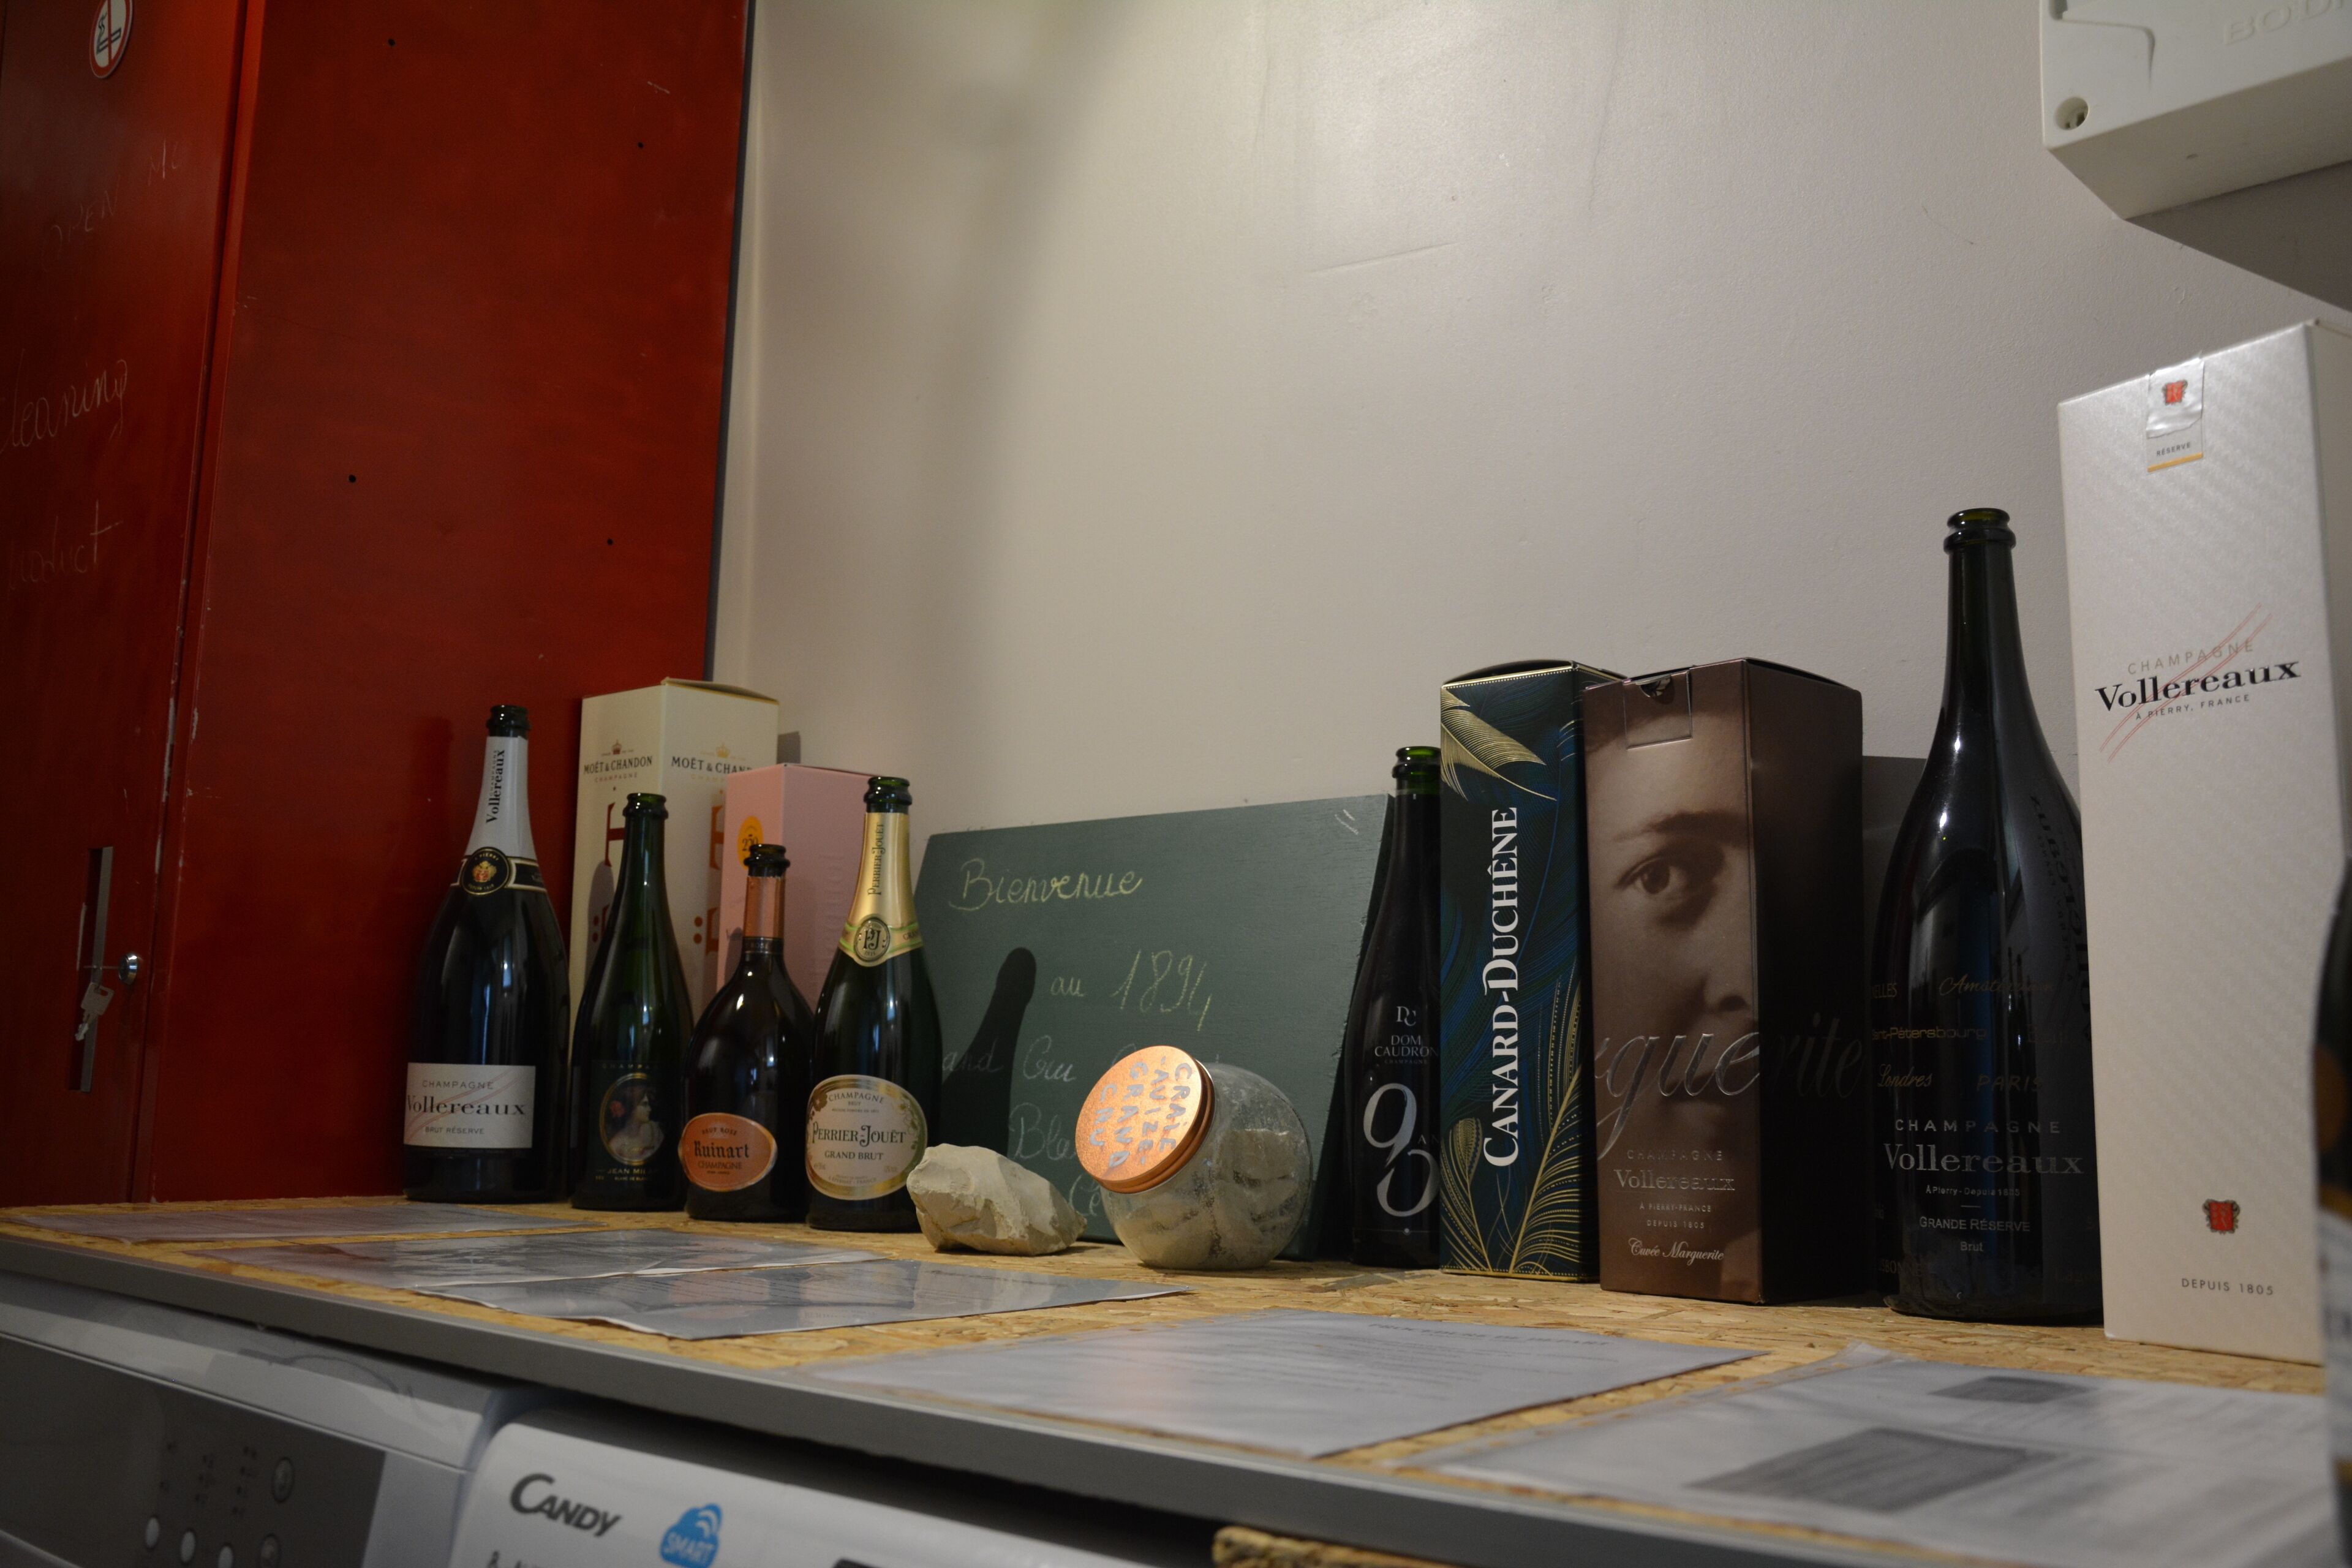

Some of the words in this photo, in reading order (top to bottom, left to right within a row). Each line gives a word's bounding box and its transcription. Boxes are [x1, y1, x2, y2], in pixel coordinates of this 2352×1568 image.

[2156, 442, 2191, 456] RÉSERVE
[2128, 638, 2254, 674] CHAMPAGNE
[2095, 662, 2301, 712] Vollereaux
[2201, 694, 2250, 709] FRANCE
[611, 756, 653, 771] CHANDON
[671, 755, 704, 771] MOËT
[706, 762, 713, 772] &
[486, 750, 505, 823] Vollereaux
[949, 858, 1143, 911] Bienvenue
[1050, 976, 1085, 997] au
[1109, 949, 1212, 1031] 1894
[1391, 1035, 1422, 1046] DOM
[942, 1038, 1004, 1073] and
[1374, 1046, 1439, 1057] CAUDRON
[1876, 1063, 1933, 1088] Londres
[1977, 1073, 2044, 1093] PARIS
[423, 1079, 494, 1090] CHAMPAGNE
[407, 1095, 526, 1115] Vollereaux
[828, 1091, 884, 1104] CHAMPAGNE
[446, 1125, 485, 1134] RÉSERVE
[1895, 1119, 2060, 1134] CHAMPAGNE
[694, 1140, 749, 1158] Ruinart
[824, 1150, 856, 1159] GRAND
[858, 1152, 883, 1161] BRUT
[1626, 1149, 1722, 1161] CHAMPAGNE
[1883, 1142, 2085, 1175] Vollereaux
[1613, 1169, 1735, 1191] Vollereaux
[1646, 1219, 1677, 1228] DEPUIS
[1919, 1215, 1967, 1230] GRANDE
[1970, 1218, 2030, 1232] RÉSERVE
[1628, 1237, 1660, 1256] Cuvée
[1662, 1241, 1725, 1266] Marguerite
[1960, 1241, 1984, 1253] Brut
[2181, 1278, 2230, 1292] DEPUIS
[2239, 1283, 2274, 1296] 1805
